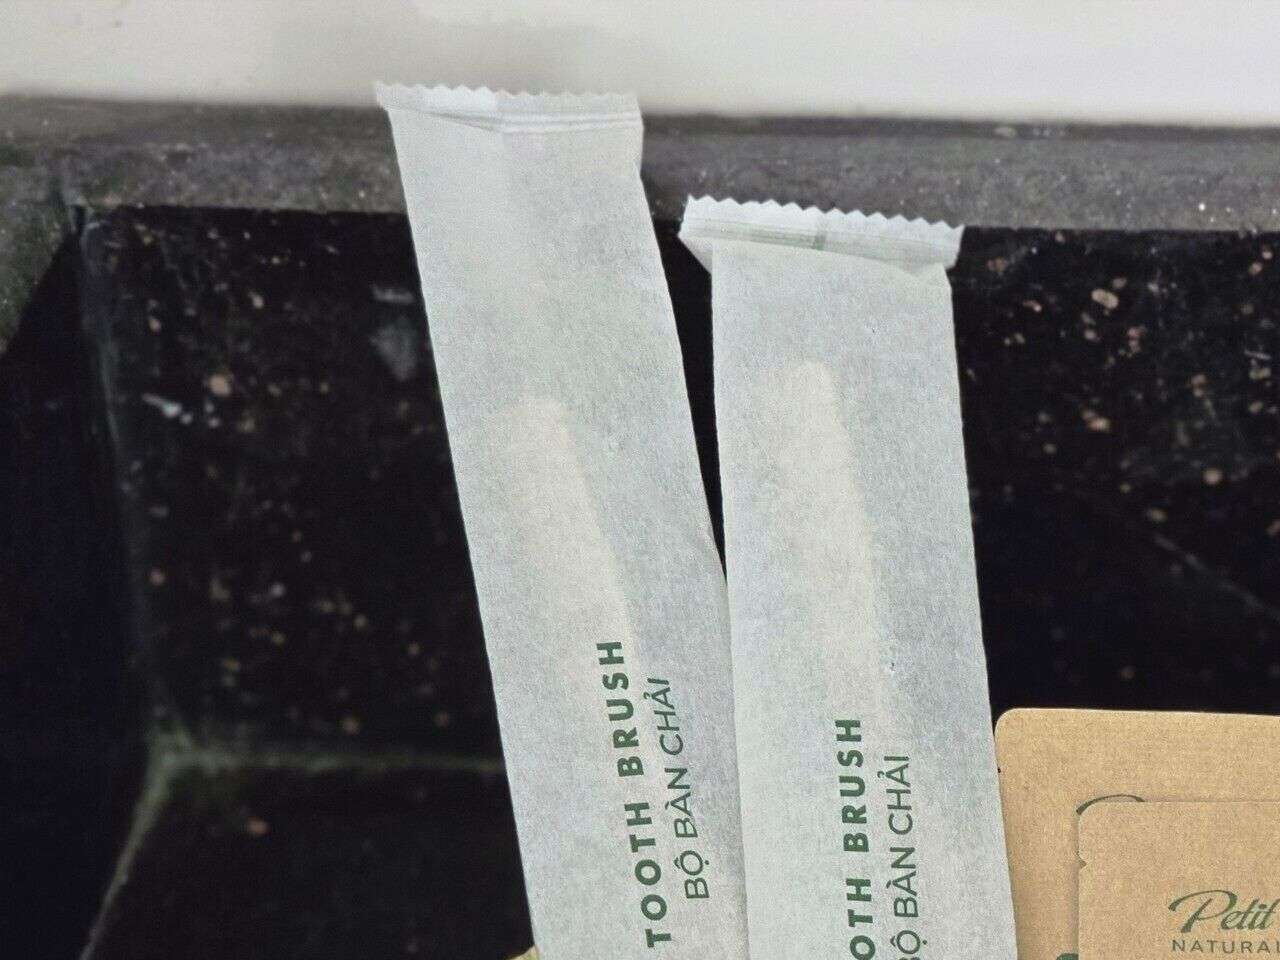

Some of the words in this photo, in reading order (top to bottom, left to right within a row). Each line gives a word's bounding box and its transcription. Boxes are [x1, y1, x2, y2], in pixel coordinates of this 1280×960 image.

[596, 641, 644, 777] BRUSH
[643, 677, 684, 756] CHẢI
[664, 767, 698, 838] BÀN
[834, 719, 870, 852] BRUSH
[877, 755, 913, 836] CHẢI
[624, 802, 672, 948] TOOTH
[673, 850, 710, 900] BỘ
[886, 847, 919, 918] BÀN
